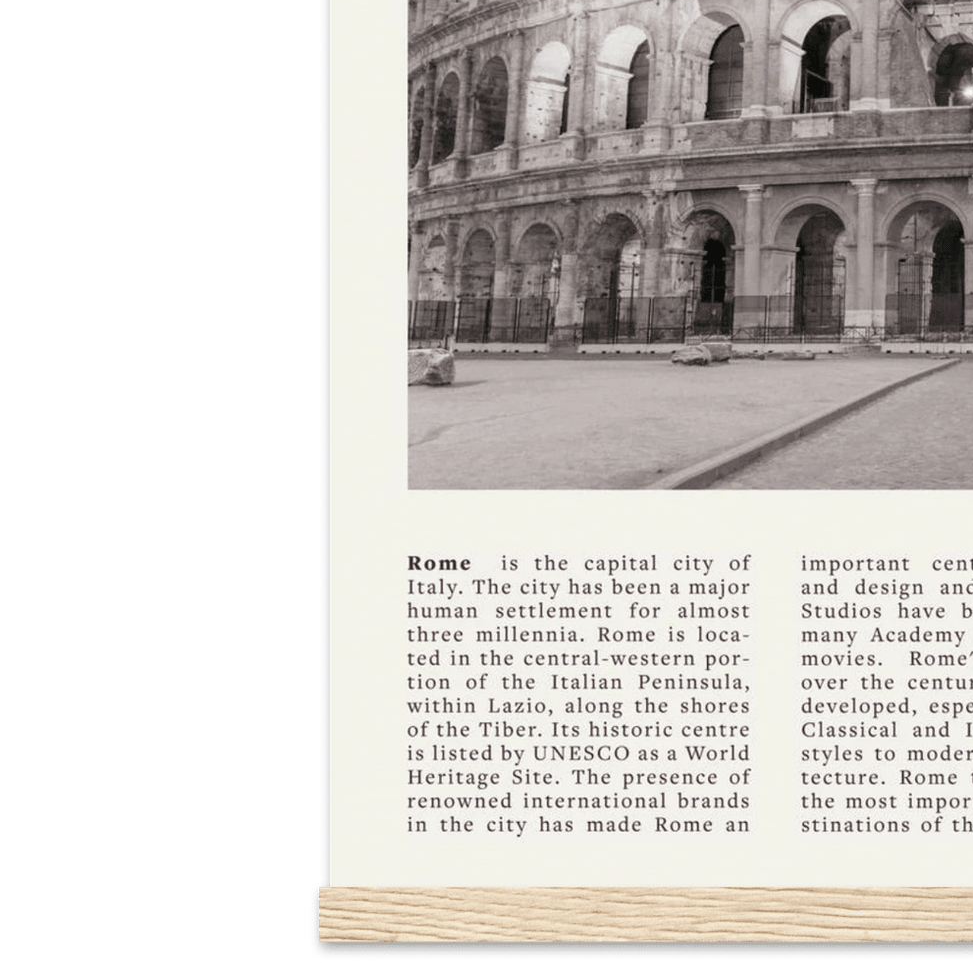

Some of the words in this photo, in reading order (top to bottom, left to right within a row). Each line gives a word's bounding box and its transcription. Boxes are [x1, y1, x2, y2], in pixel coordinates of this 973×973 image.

[408, 556, 470, 571] Rome
[585, 555, 656, 576] capital
[674, 555, 713, 576] city
[802, 555, 909, 576] important
[409, 578, 462, 600] Italy.
[472, 578, 511, 594] The
[520, 579, 560, 599] city
[569, 578, 602, 594] has
[612, 578, 660, 594] been
[689, 579, 750, 599] major
[802, 579, 838, 595] and
[855, 579, 923, 600] design
[408, 602, 477, 618] human
[496, 602, 611, 618] settlement
[630, 602, 660, 618] for
[678, 602, 749, 618] almost
[802, 602, 881, 618] Studios
[898, 602, 945, 618] have
[408, 626, 463, 642] three
[477, 626, 584, 642] millennia.
[598, 627, 655, 642] Rome
[698, 626, 749, 642] loca-
[802, 631, 857, 647] many
[871, 626, 965, 647] Academy
[408, 650, 440, 666] ted
[480, 650, 513, 666] the
[524, 650, 694, 666] central-western
[706, 654, 749, 671] por-
[802, 651, 882, 666] movies.
[408, 674, 449, 689] tion
[502, 674, 535, 689] the
[552, 673, 621, 689] Italian
[639, 674, 749, 692] Peninsula,
[801, 679, 847, 690] over
[861, 674, 894, 690] the
[407, 697, 475, 713] within
[489, 698, 553, 716] Lazio,
[566, 697, 623, 718] along
[635, 697, 667, 713] the
[681, 697, 749, 713] shores
[802, 697, 916, 718] developed,
[437, 721, 469, 737] the
[479, 721, 541, 737] Tiber.
[553, 722, 579, 737] Its
[589, 721, 672, 737] historic
[682, 725, 749, 737] centre
[802, 721, 896, 737] Classical
[913, 721, 949, 737] and
[433, 745, 492, 761] listed
[534, 746, 629, 761] UNESCO
[686, 745, 749, 761] World
[802, 745, 862, 766] styles
[408, 769, 499, 789] Heritage
[513, 769, 559, 784] Site.
[572, 768, 610, 784] The
[623, 773, 717, 789] presence
[801, 772, 885, 785] tecture.
[900, 770, 957, 785] Rome
[408, 792, 511, 808] renowned
[524, 792, 665, 808] international
[678, 792, 749, 808] brands
[846, 796, 896, 808] most
[487, 817, 526, 837] city
[540, 816, 573, 832] has
[587, 816, 641, 832] made
[656, 817, 712, 832] Rome
[802, 817, 909, 832] stinations
